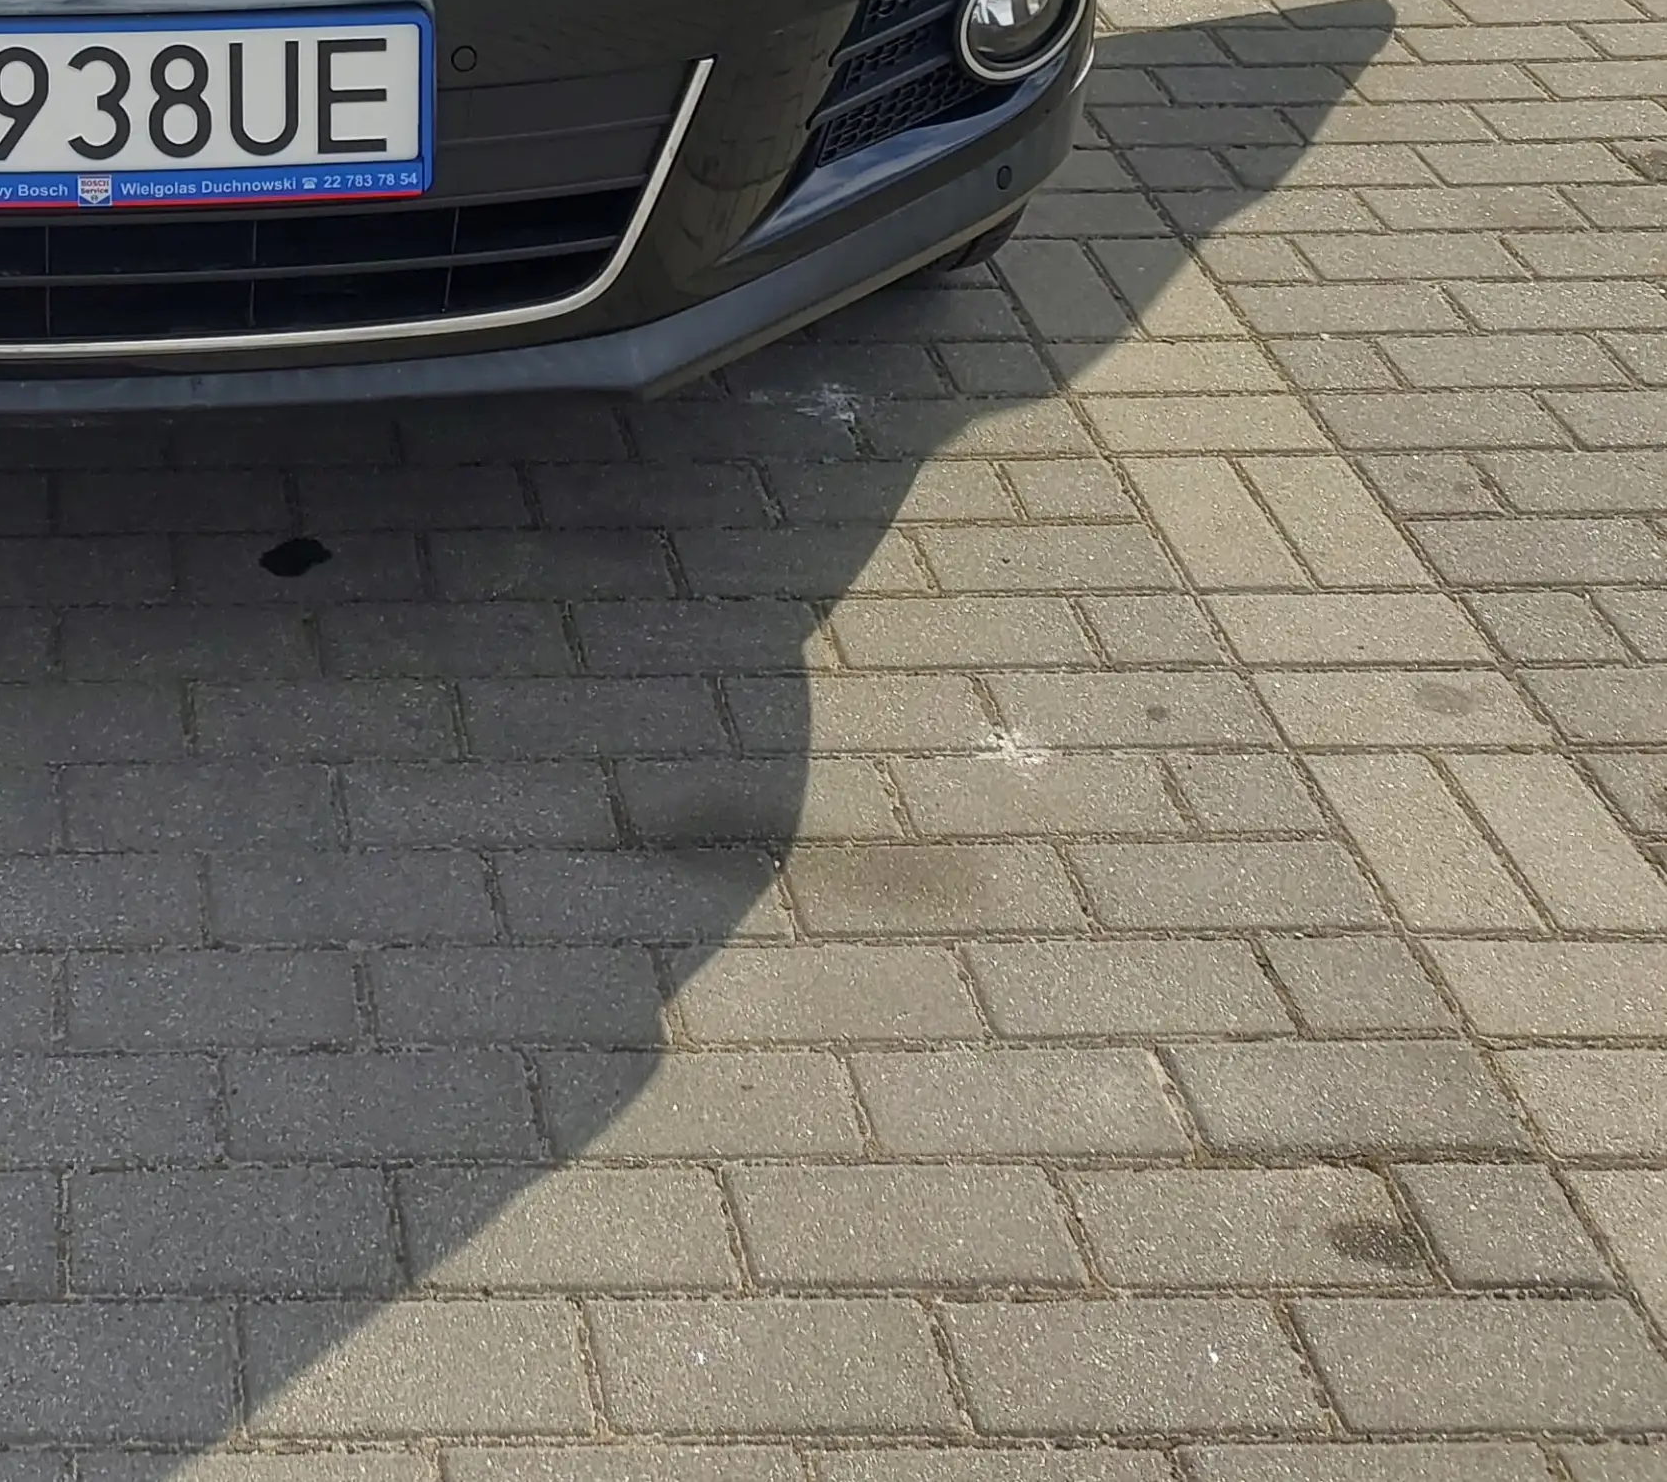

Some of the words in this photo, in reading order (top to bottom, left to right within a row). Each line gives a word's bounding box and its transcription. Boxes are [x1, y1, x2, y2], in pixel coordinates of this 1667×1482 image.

[80, 179, 109, 187] BOSCH
[120, 181, 197, 197] Wielgolas
[201, 177, 297, 193] Duchnowski
[323, 175, 341, 188] 22
[346, 174, 373, 187] 783
[377, 173, 395, 186] 78
[400, 172, 418, 185] 54
[18, 184, 68, 197] Bosch
[80, 186, 109, 194] Service
